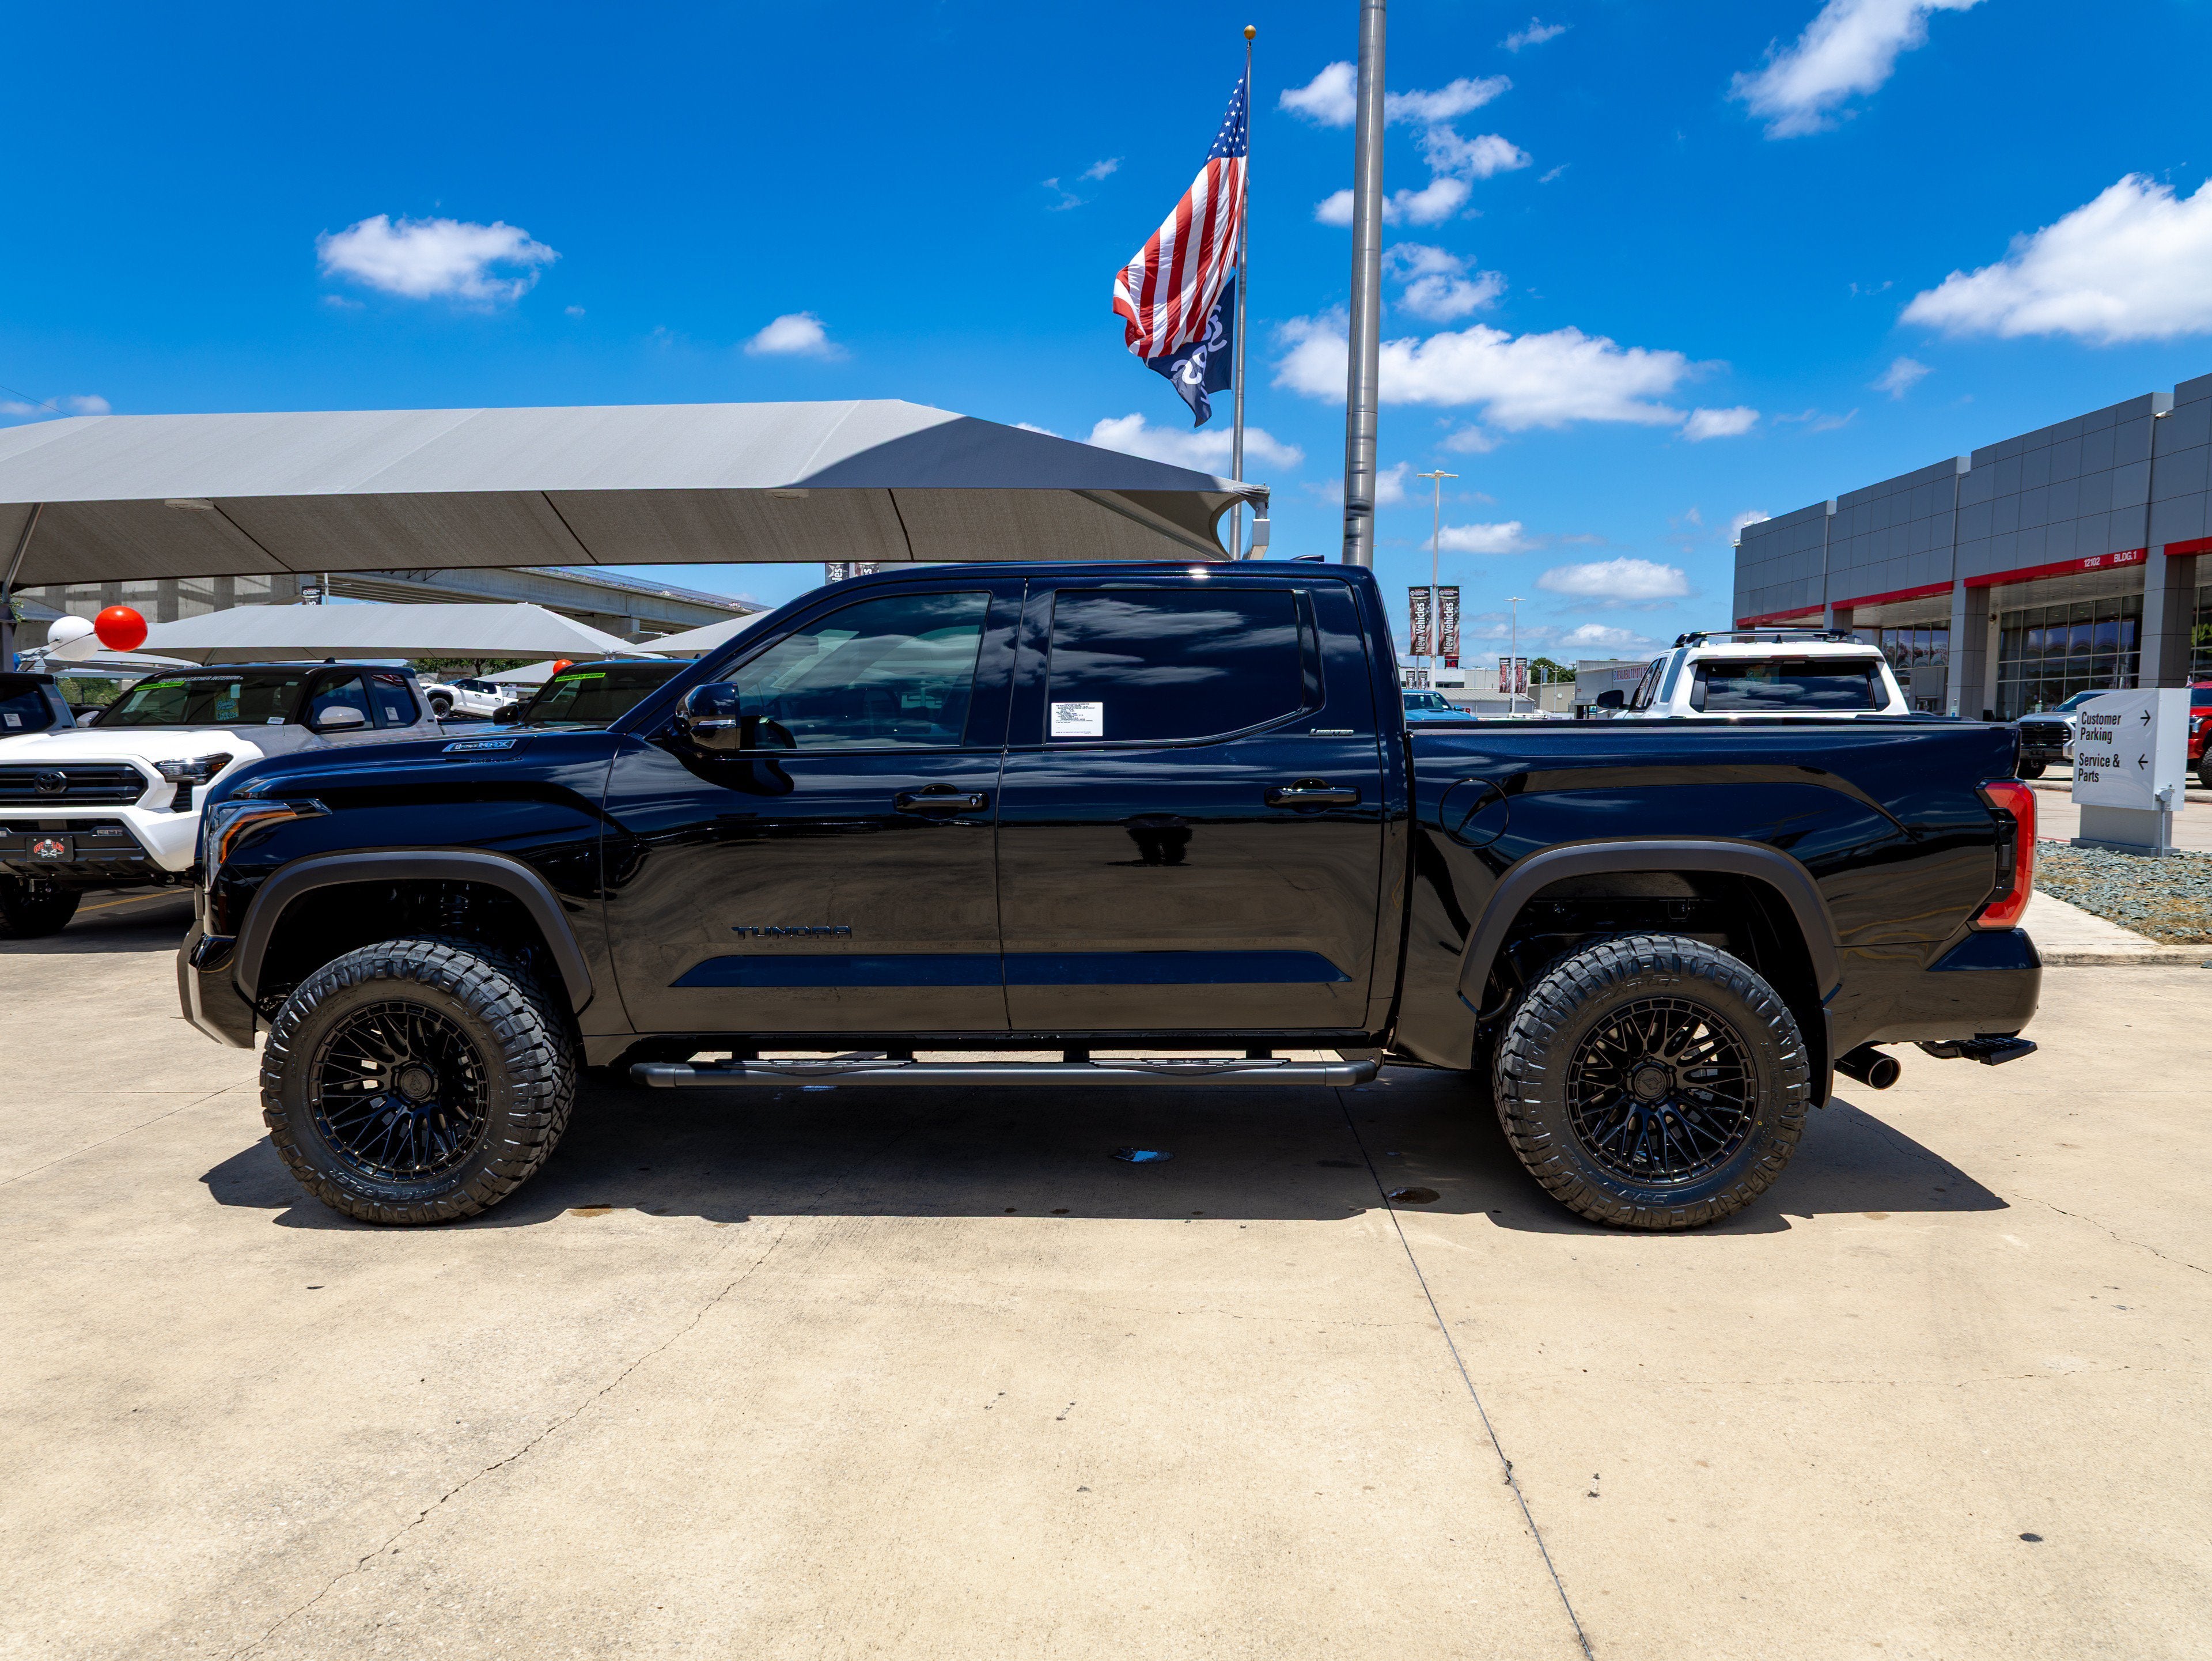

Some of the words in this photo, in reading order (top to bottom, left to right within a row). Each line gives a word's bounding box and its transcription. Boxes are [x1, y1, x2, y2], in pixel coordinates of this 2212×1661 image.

[2084, 557, 2101, 567] 12102
[1415, 602, 1426, 635] Vehicles
[1443, 602, 1454, 635] Vehicles
[1415, 635, 1426, 653] New
[1443, 635, 1453, 653] New
[2081, 711, 2122, 725] Customer
[2080, 727, 2113, 744] Parking
[2078, 752, 2111, 767] Service
[2112, 753, 2120, 768] &
[2077, 767, 2099, 782] Parts
[731, 925, 852, 940] TUNDRA
